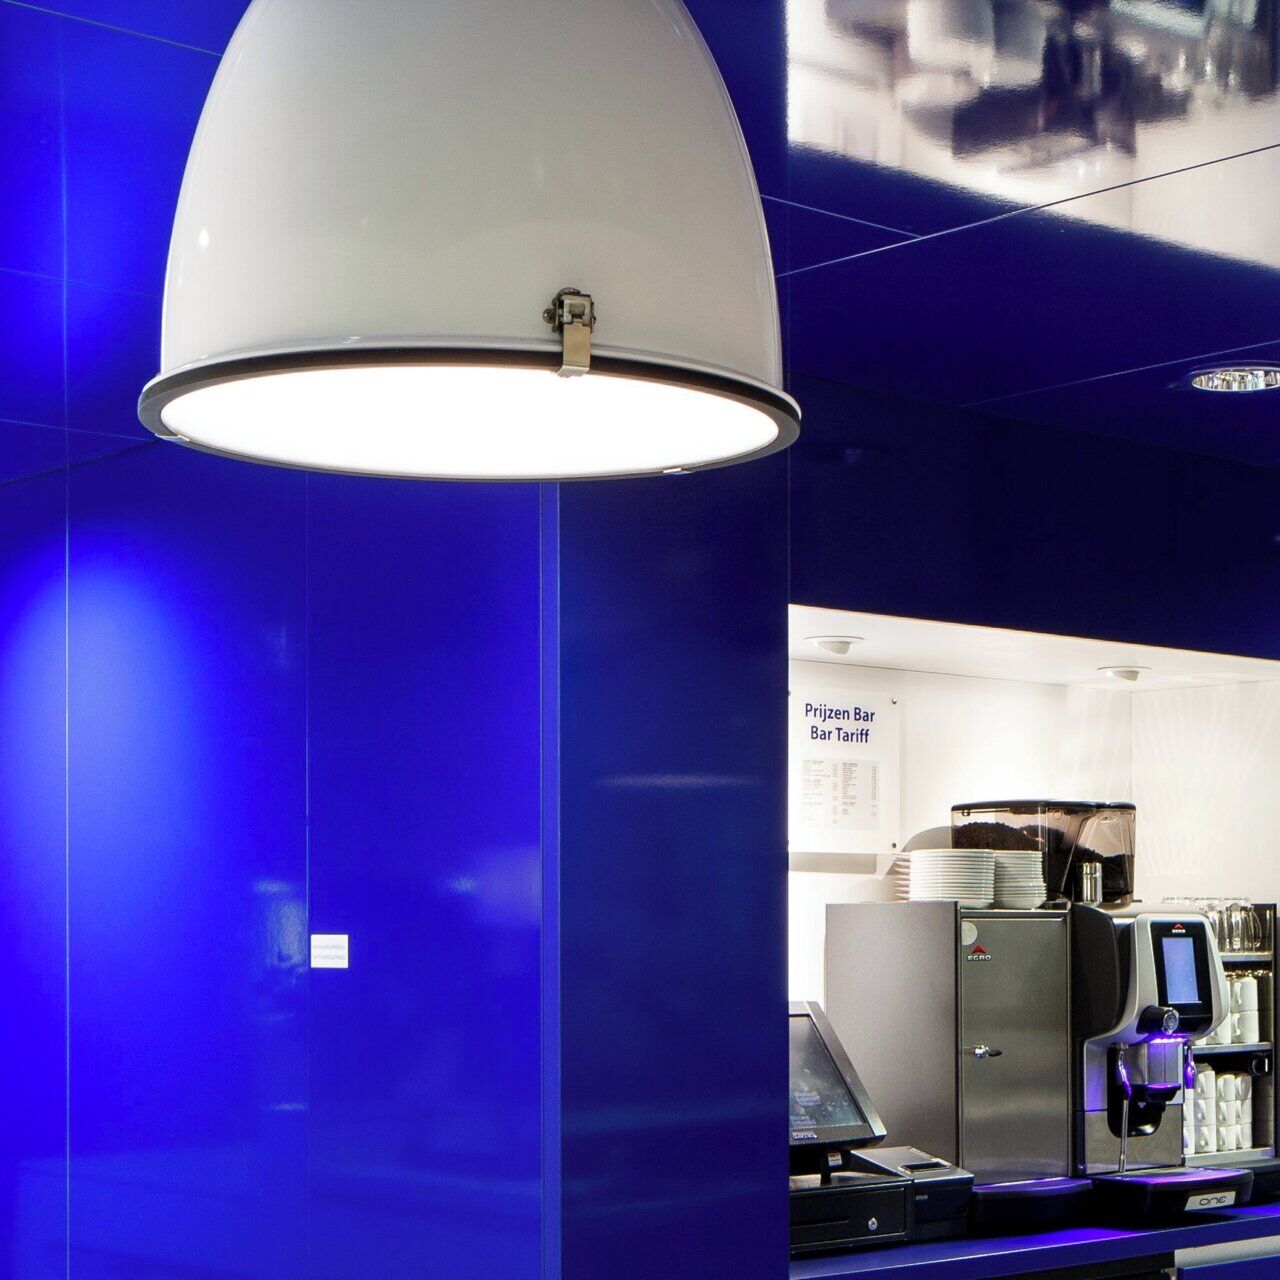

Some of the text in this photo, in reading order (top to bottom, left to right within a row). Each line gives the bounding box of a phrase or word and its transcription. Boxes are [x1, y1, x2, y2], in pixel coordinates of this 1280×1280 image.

[805, 703, 875, 722] Prijzen Bar
[811, 725, 870, 743] Bar Tariff
